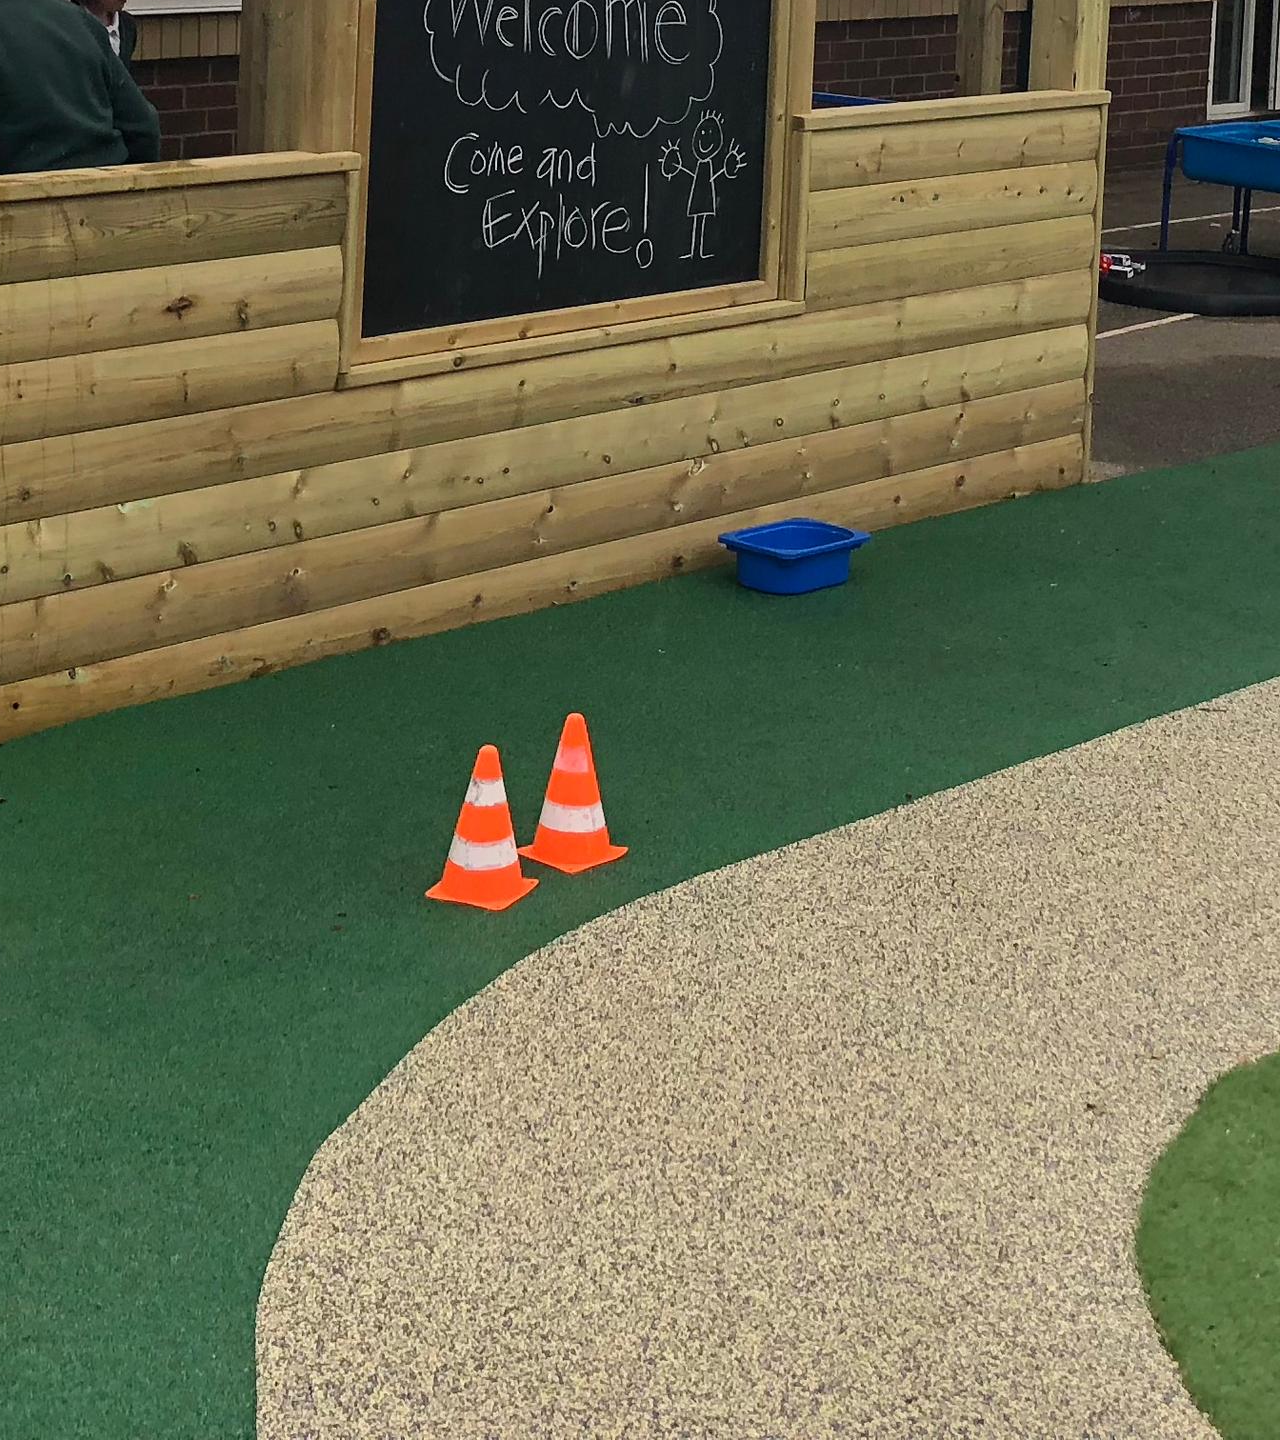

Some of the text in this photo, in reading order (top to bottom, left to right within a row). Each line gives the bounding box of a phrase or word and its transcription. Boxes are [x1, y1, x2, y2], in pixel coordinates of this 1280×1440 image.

[444, 132, 596, 193] Come and
[482, 164, 654, 279] Explore!
